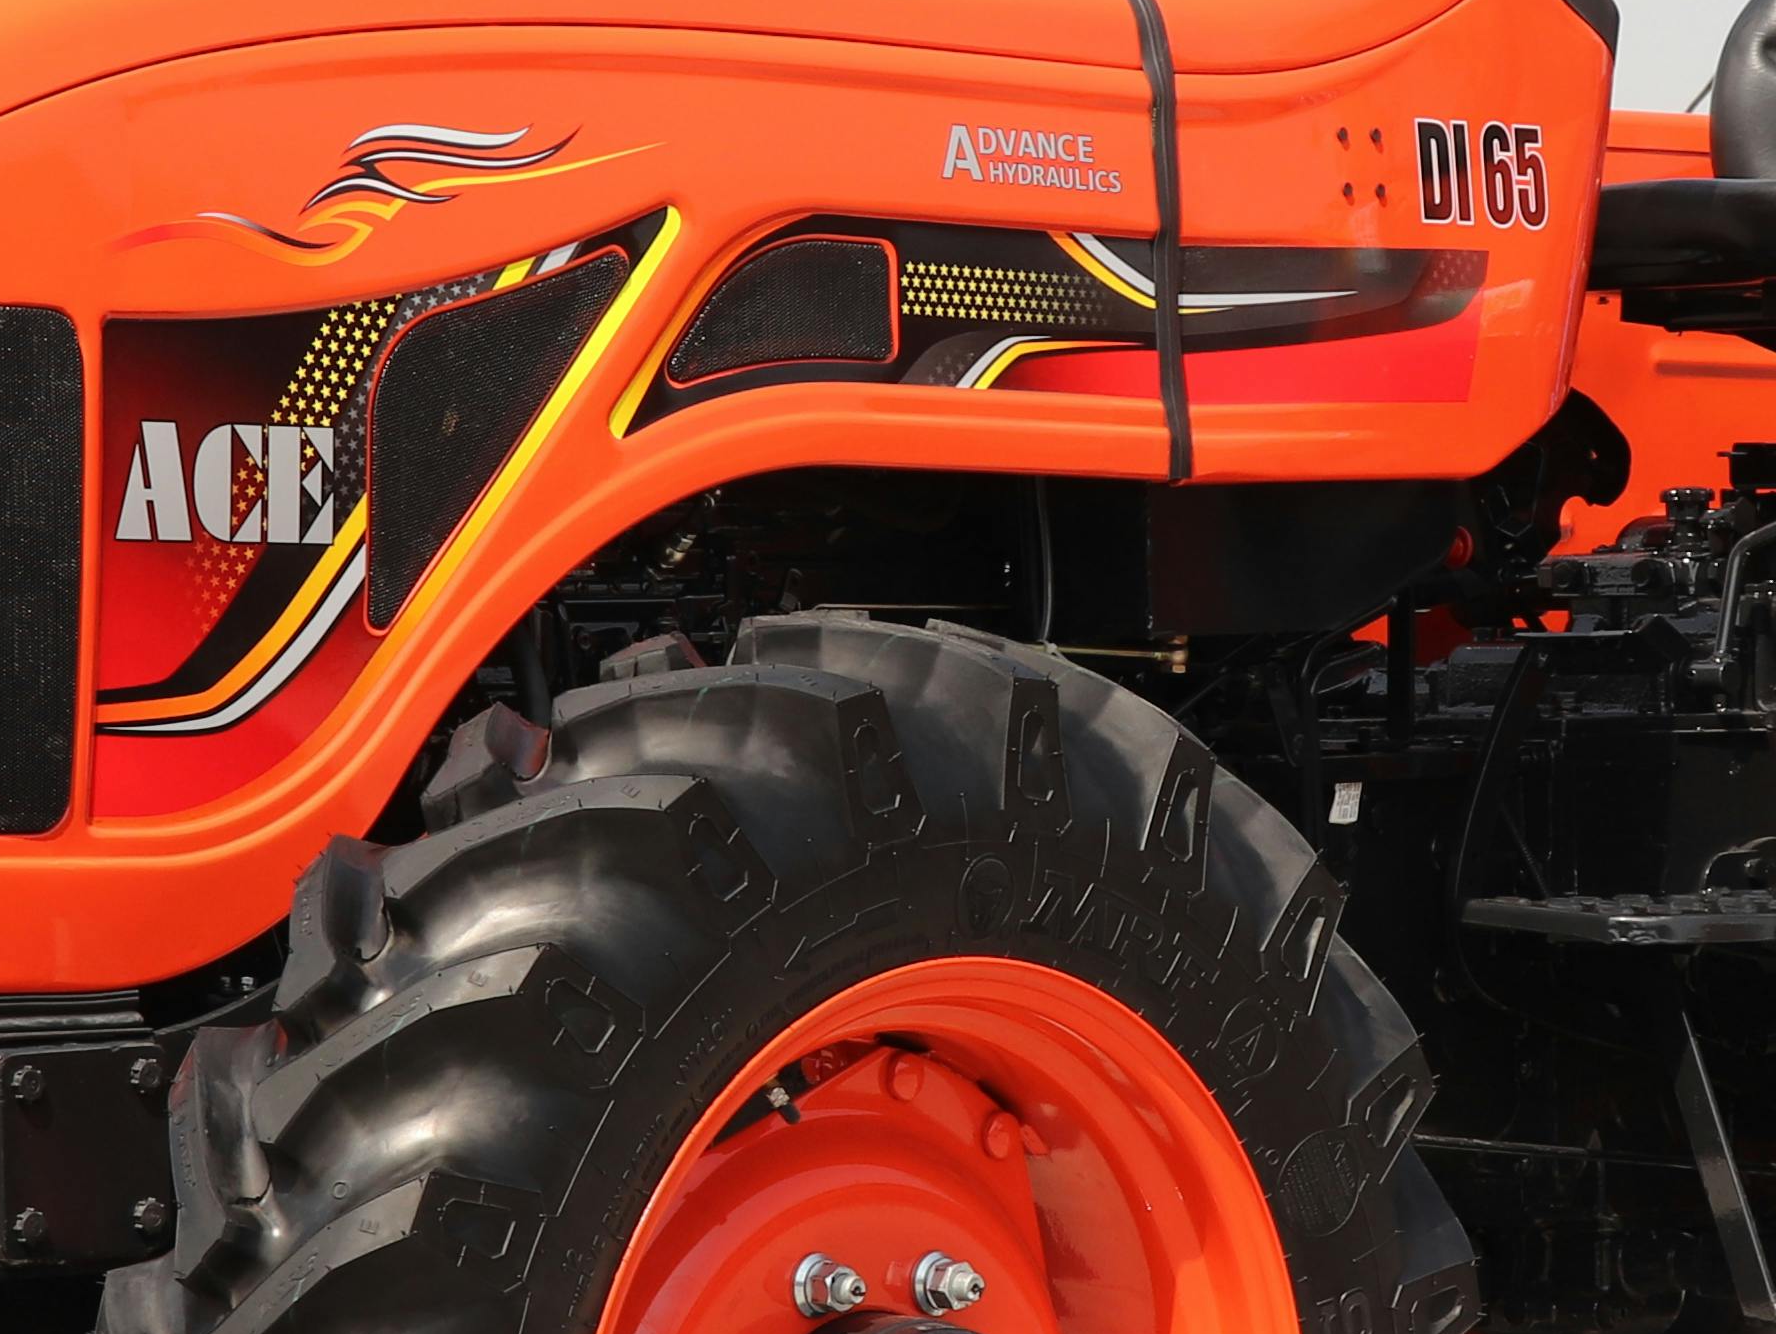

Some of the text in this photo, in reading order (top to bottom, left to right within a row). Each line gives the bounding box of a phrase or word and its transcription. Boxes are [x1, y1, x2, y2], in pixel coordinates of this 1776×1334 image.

[941, 123, 1094, 181] ADVANCE
[988, 161, 1122, 195] HYDRAULICS
[1414, 117, 1549, 231] DI 65
[115, 420, 335, 545] ACE
